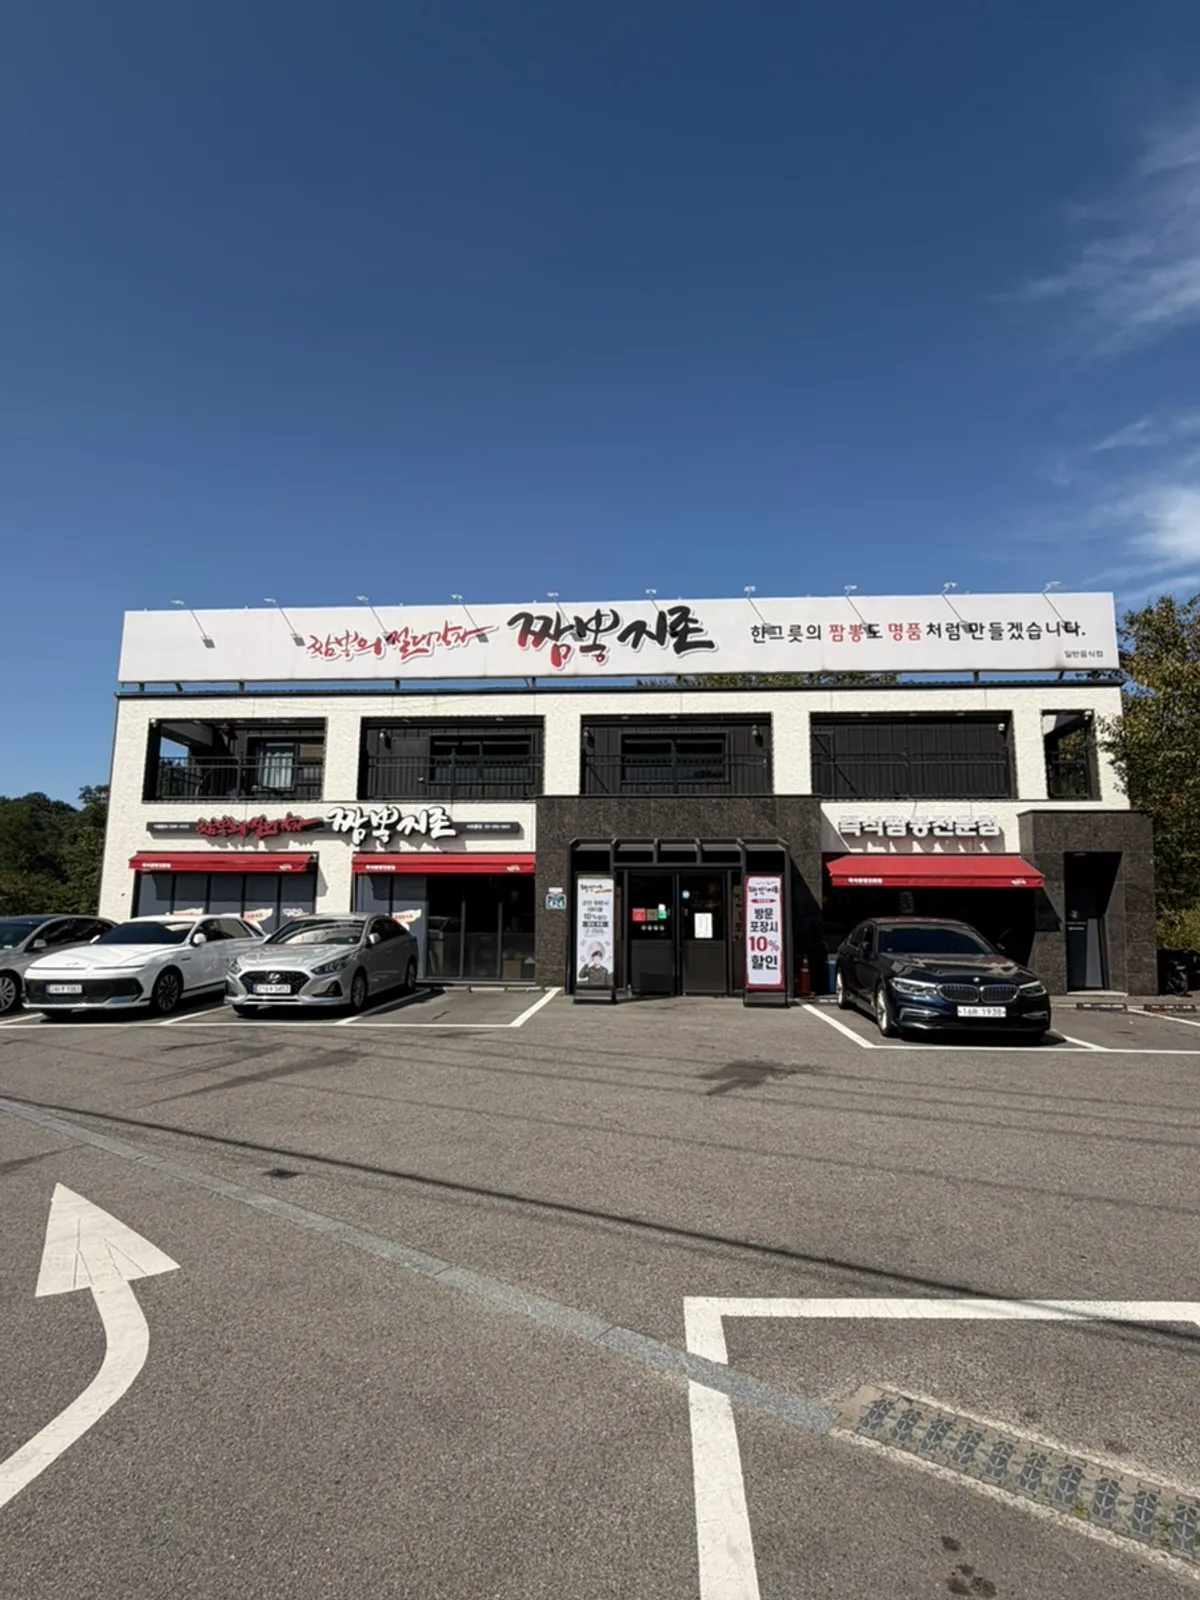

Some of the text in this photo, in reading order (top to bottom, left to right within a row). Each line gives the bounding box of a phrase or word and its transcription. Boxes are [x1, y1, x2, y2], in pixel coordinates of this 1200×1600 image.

[507, 606, 715, 667] 짬뽕지존
[750, 624, 822, 644] 한그릇의
[829, 623, 883, 643] 짬뽕도
[1064, 650, 1104, 658] 일반음식점
[327, 806, 457, 845] 짬뽕지존
[754, 908, 774, 920] 방문
[750, 921, 778, 933] 포장시
[748, 936, 780, 952] 10%
[751, 955, 778, 970] 할인
